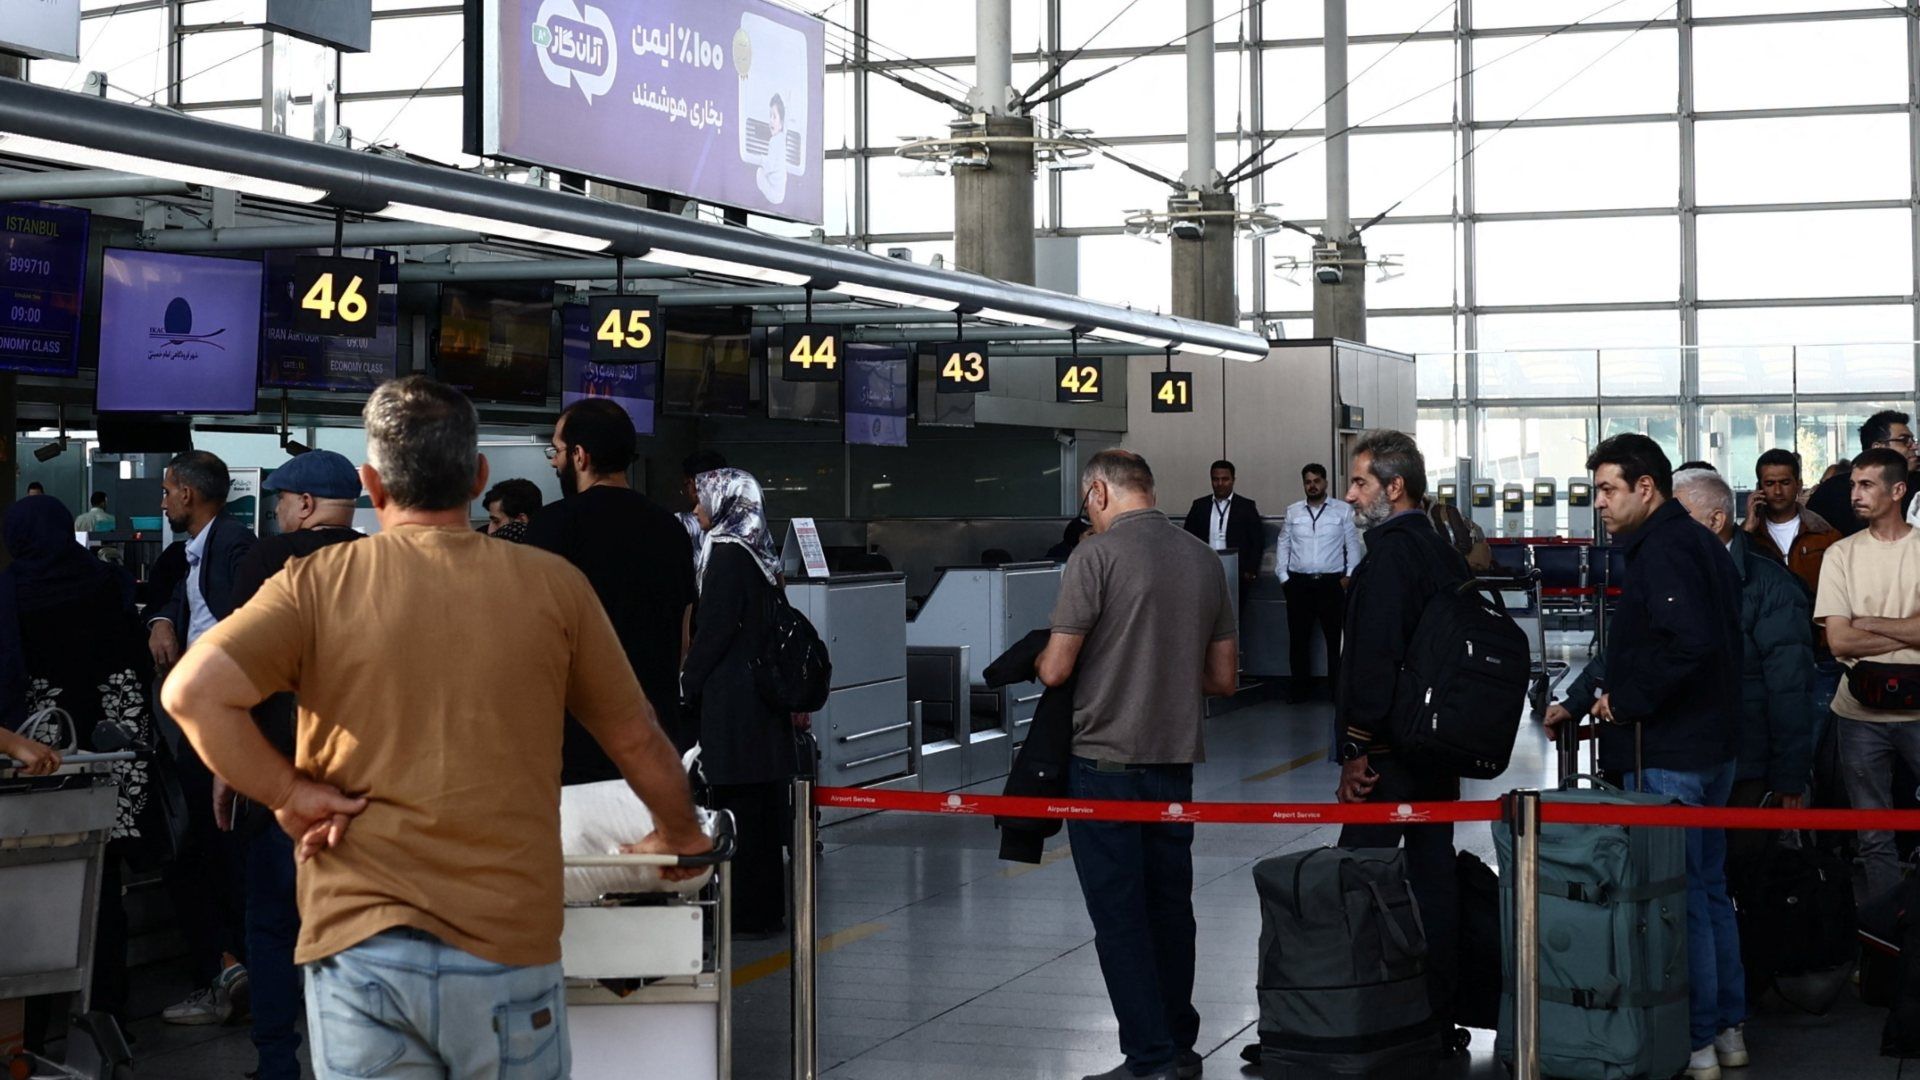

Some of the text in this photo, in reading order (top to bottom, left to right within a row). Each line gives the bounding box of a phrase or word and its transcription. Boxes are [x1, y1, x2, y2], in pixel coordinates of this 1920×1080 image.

[632, 22, 675, 68] ایمن
[632, 82, 723, 135] بخاری هوشمند
[6, 215, 60, 238] ISTANBUL
[9, 256, 51, 276] B99710
[301, 272, 368, 322] 46
[11, 305, 41, 323] 09:00
[268, 327, 287, 341] IRAN
[596, 308, 652, 349] 45
[32, 339, 61, 353] CLASS
[789, 335, 837, 369] 44
[330, 360, 384, 374] ECONOMY CLASS
[942, 352, 985, 383] 43
[1060, 365, 1098, 393] 42
[1157, 380, 1187, 405] 41
[853, 795, 876, 803] Service
[1047, 805, 1094, 814] Airport Service
[1273, 811, 1321, 819] Airport Service
